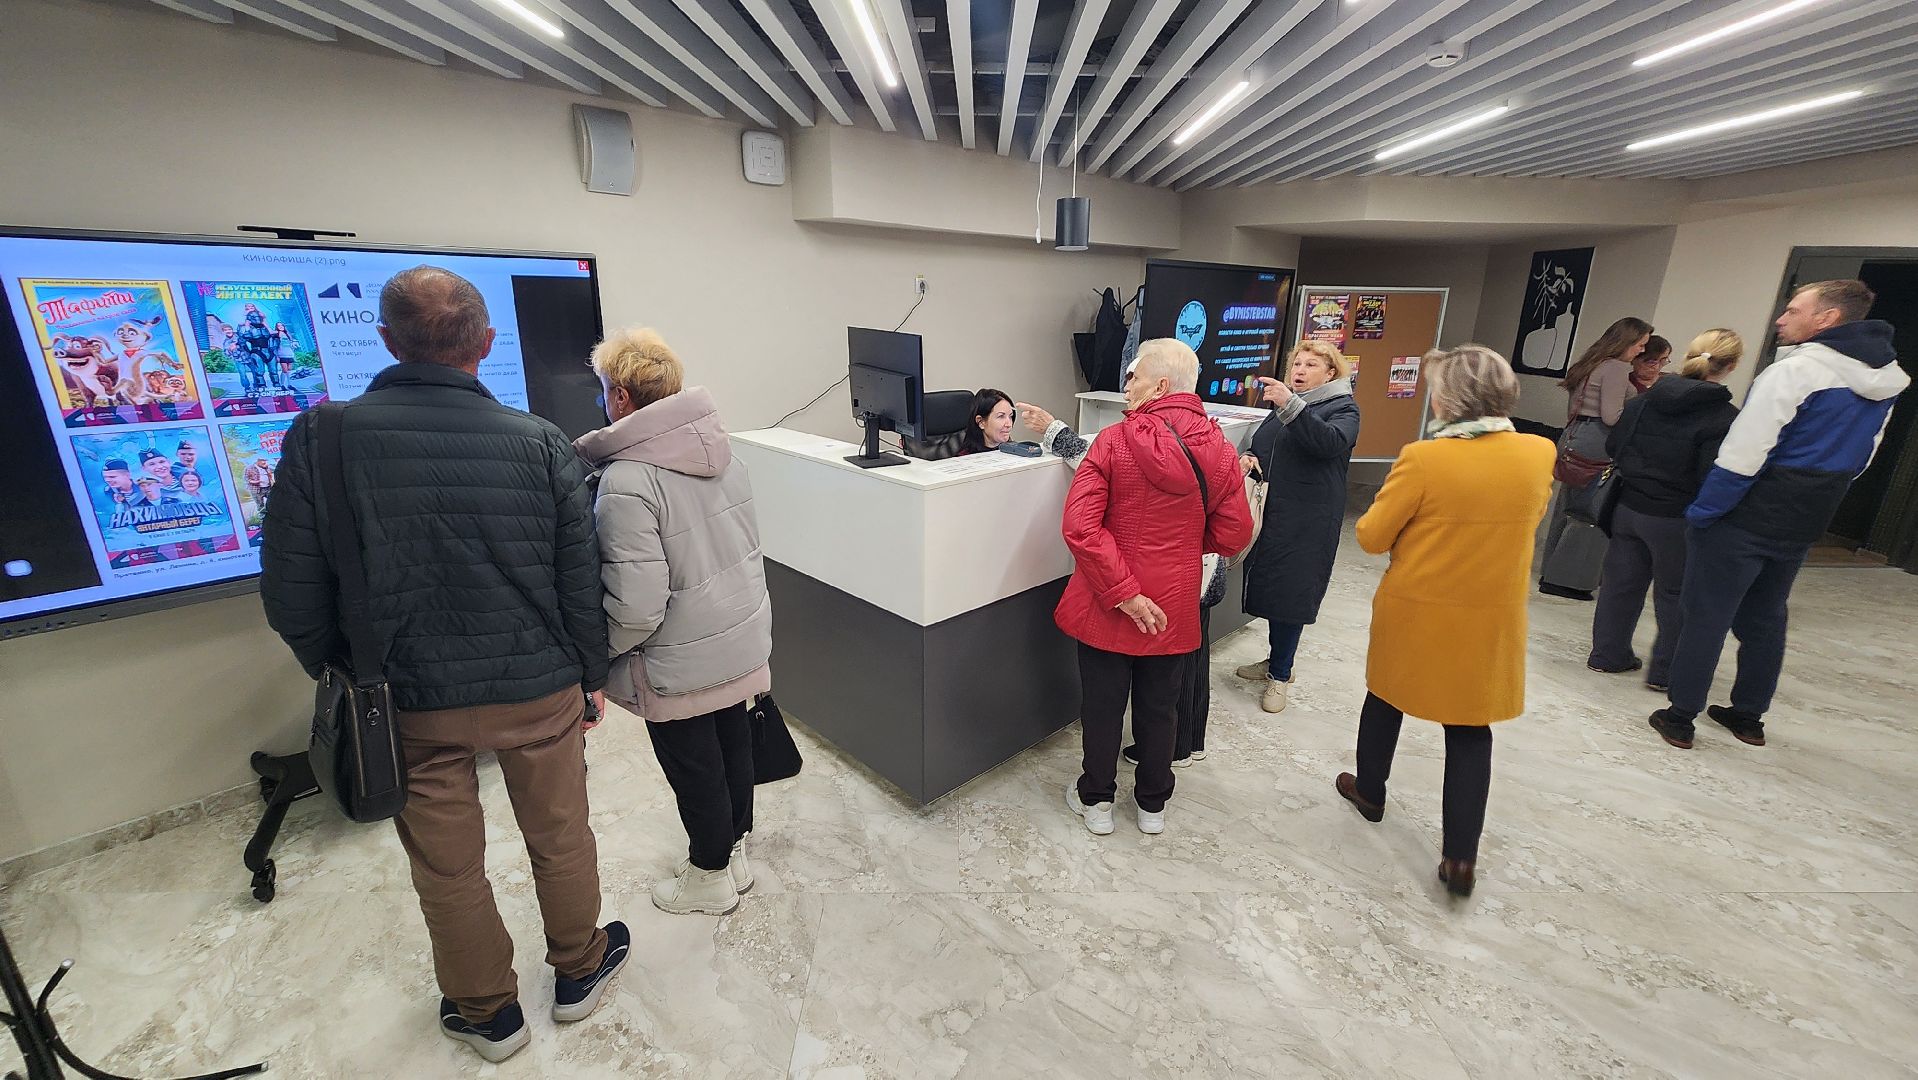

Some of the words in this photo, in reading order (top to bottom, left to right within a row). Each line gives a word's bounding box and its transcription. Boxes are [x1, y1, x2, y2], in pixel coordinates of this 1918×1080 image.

[242, 254, 313, 265] КИНОАФИША
[215, 291, 292, 300] ИНТЕЛЛЕКТ
[330, 340, 337, 348] 2
[339, 340, 378, 348] ОКТЯБРЯ
